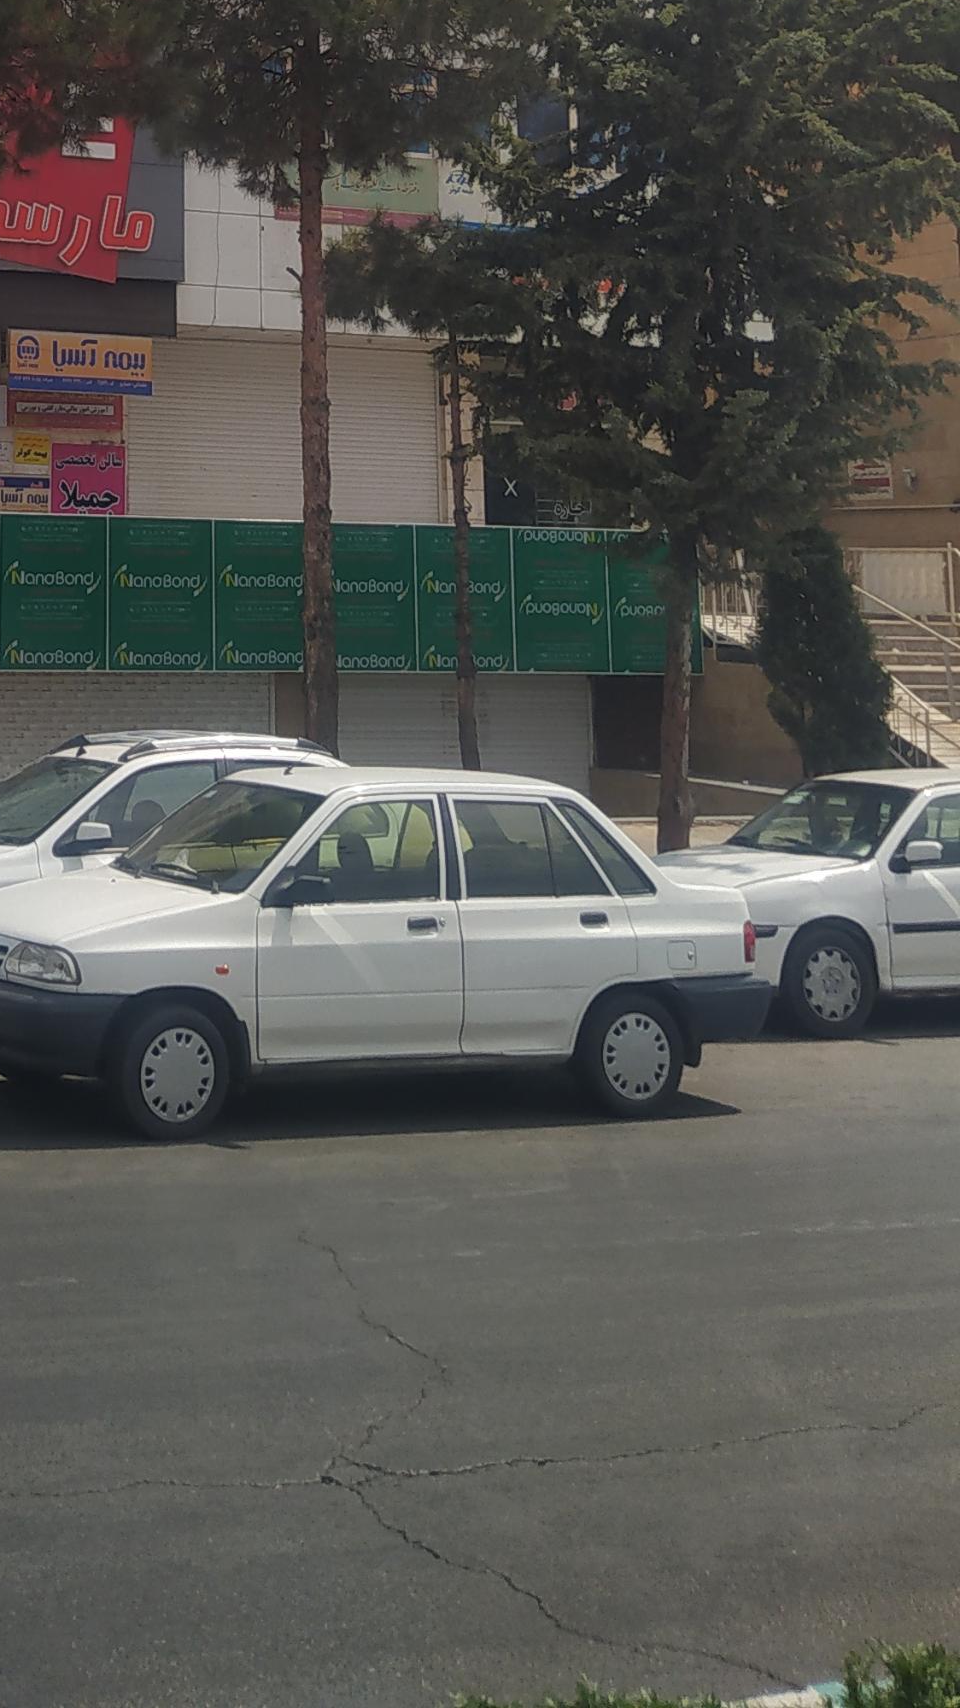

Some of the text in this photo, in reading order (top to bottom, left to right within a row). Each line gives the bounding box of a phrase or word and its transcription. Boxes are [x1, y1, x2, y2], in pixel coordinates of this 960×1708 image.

[52, 339, 146, 378] بیمه آسیا
[55, 451, 123, 471] سالن تخصصی
[58, 478, 120, 515] جمیلا
[10, 569, 95, 588] NanoBond
[120, 571, 201, 590] NanoBond
[224, 571, 304, 589] NanoBond
[10, 648, 94, 667] NanoBond
[120, 650, 200, 668] NanoBond
[224, 646, 304, 666] NanoBond
